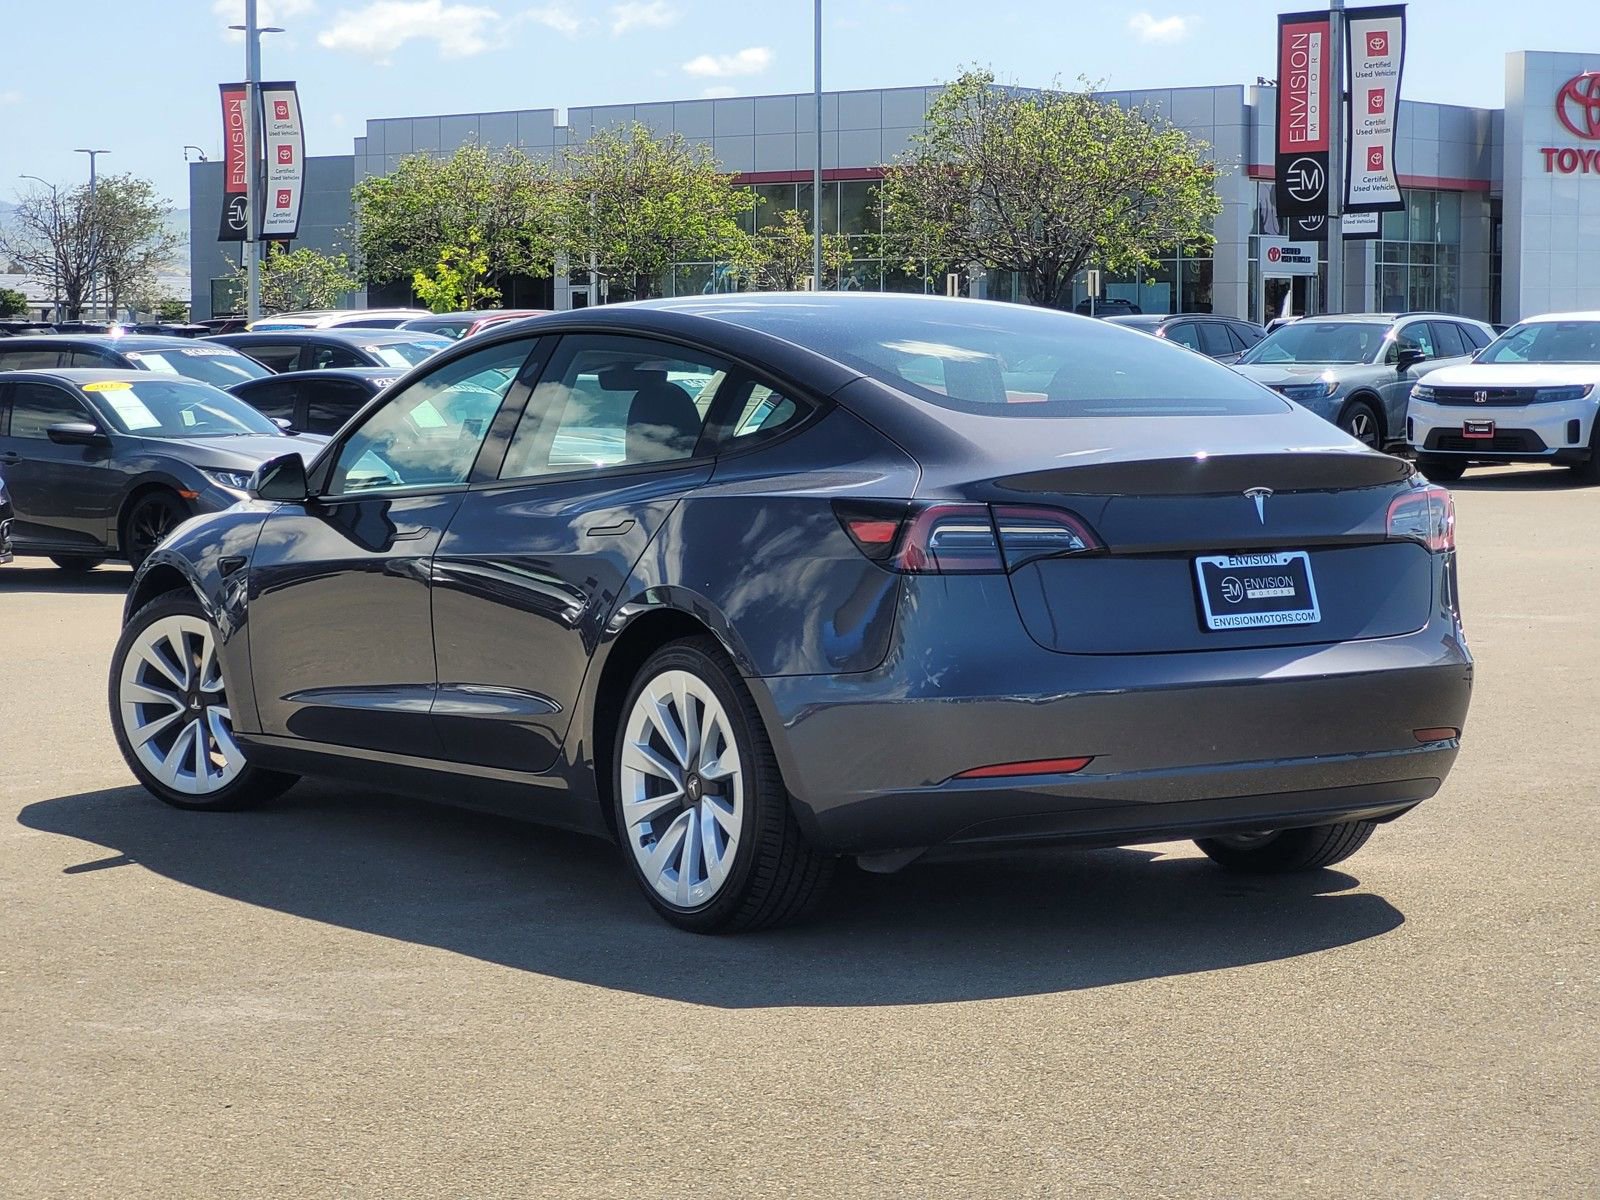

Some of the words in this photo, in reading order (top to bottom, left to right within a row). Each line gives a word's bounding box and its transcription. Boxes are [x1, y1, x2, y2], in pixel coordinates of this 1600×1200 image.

[1363, 61, 1392, 69] Certified
[1355, 71, 1373, 79] Used
[1374, 69, 1397, 78] Vehicles
[1289, 33, 1308, 143] ENVISION
[1310, 42, 1319, 132] MOTORS
[1355, 128, 1373, 136] Used
[229, 100, 244, 184] ENVISION
[1229, 554, 1278, 566] ENVISION
[1244, 576, 1294, 590] ENVISION
[1213, 612, 1316, 627] ENVISIONMOTORS.COM
